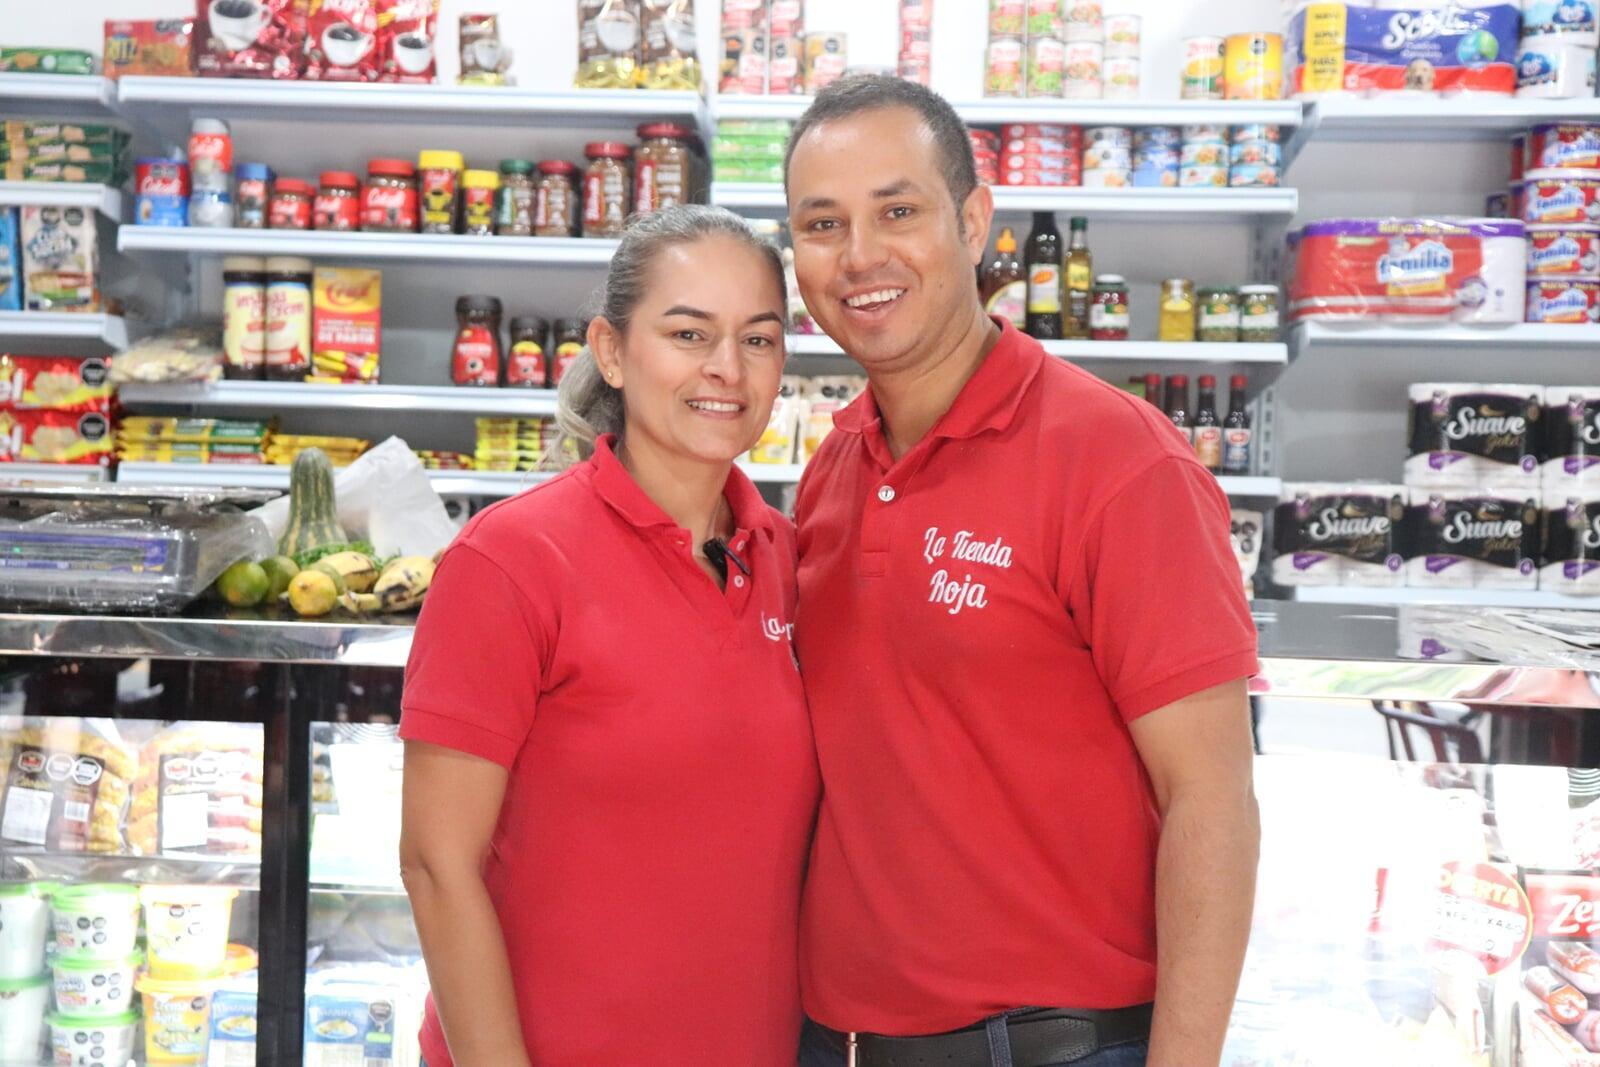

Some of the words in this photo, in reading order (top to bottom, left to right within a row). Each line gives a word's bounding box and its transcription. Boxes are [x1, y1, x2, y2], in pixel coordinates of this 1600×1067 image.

[1380, 248, 1449, 275] familia
[1447, 406, 1526, 440] Suave
[1309, 507, 1391, 541] Suave
[1442, 511, 1523, 544] Suave
[923, 527, 947, 565] La
[951, 530, 1013, 568] Tienda
[928, 569, 989, 615] Roja
